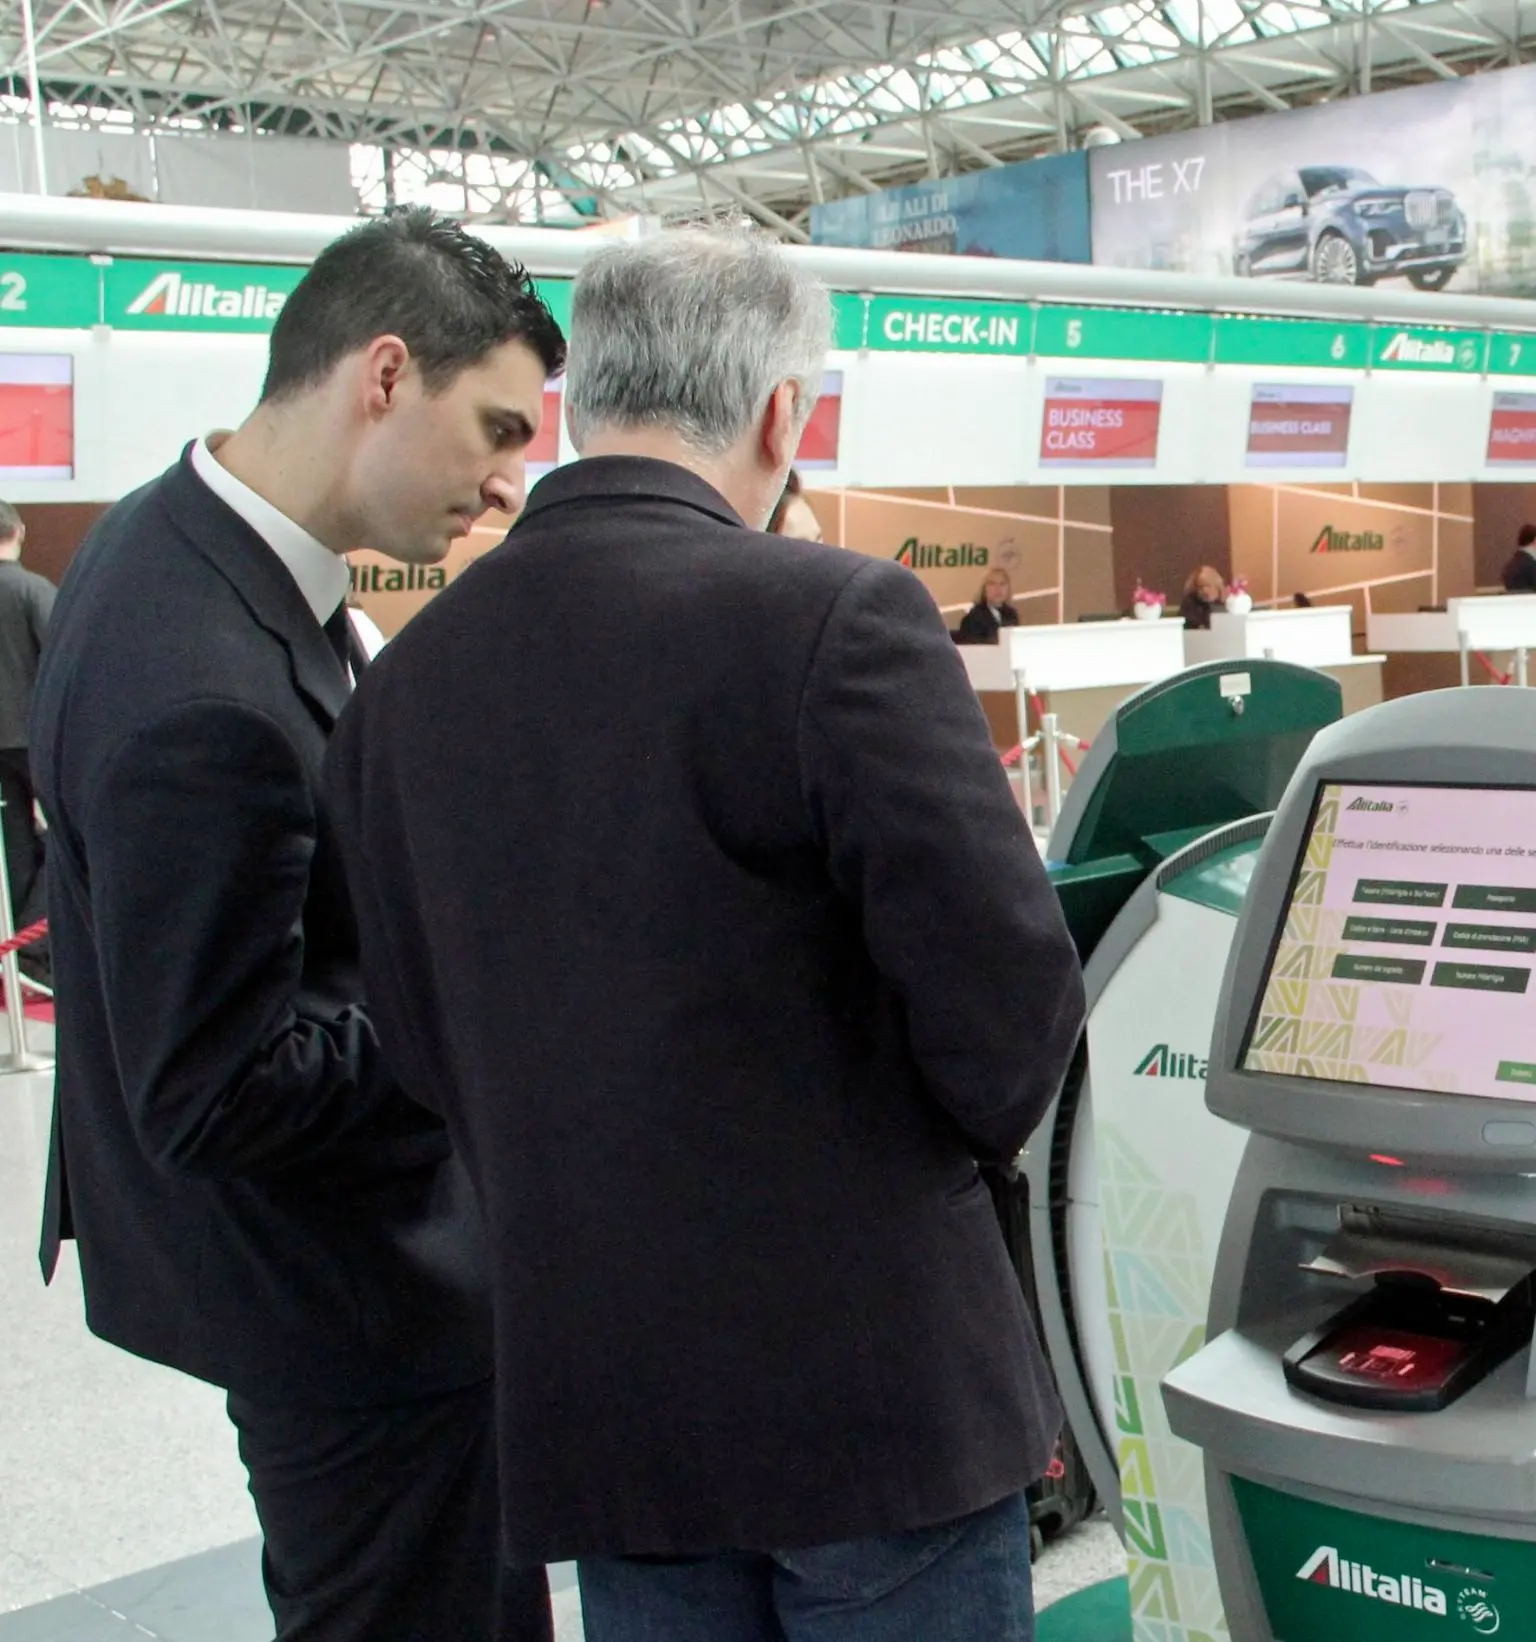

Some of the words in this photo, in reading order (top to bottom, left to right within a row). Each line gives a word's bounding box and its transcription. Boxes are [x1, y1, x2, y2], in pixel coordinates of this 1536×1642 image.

[1106, 163, 1164, 205] THE
[1172, 156, 1205, 195] X7
[0, 271, 27, 311] 2
[126, 272, 287, 319] Alitalia
[884, 311, 1018, 346] CHECK-IN
[1066, 319, 1082, 348] 5
[1331, 334, 1346, 360] 6
[1380, 333, 1454, 364] Alitalia
[1508, 343, 1521, 367] 7
[1049, 408, 1124, 428] BUSINESS
[1046, 430, 1096, 449] CLASS
[895, 538, 989, 568] Alitalia
[1310, 525, 1384, 554] Alitalia
[350, 564, 446, 592] litalia
[1346, 796, 1394, 812] Alitalia
[1332, 838, 1364, 850] Effettua
[1133, 1044, 1208, 1080] Alita
[1296, 1545, 1447, 1616] Alitalia
